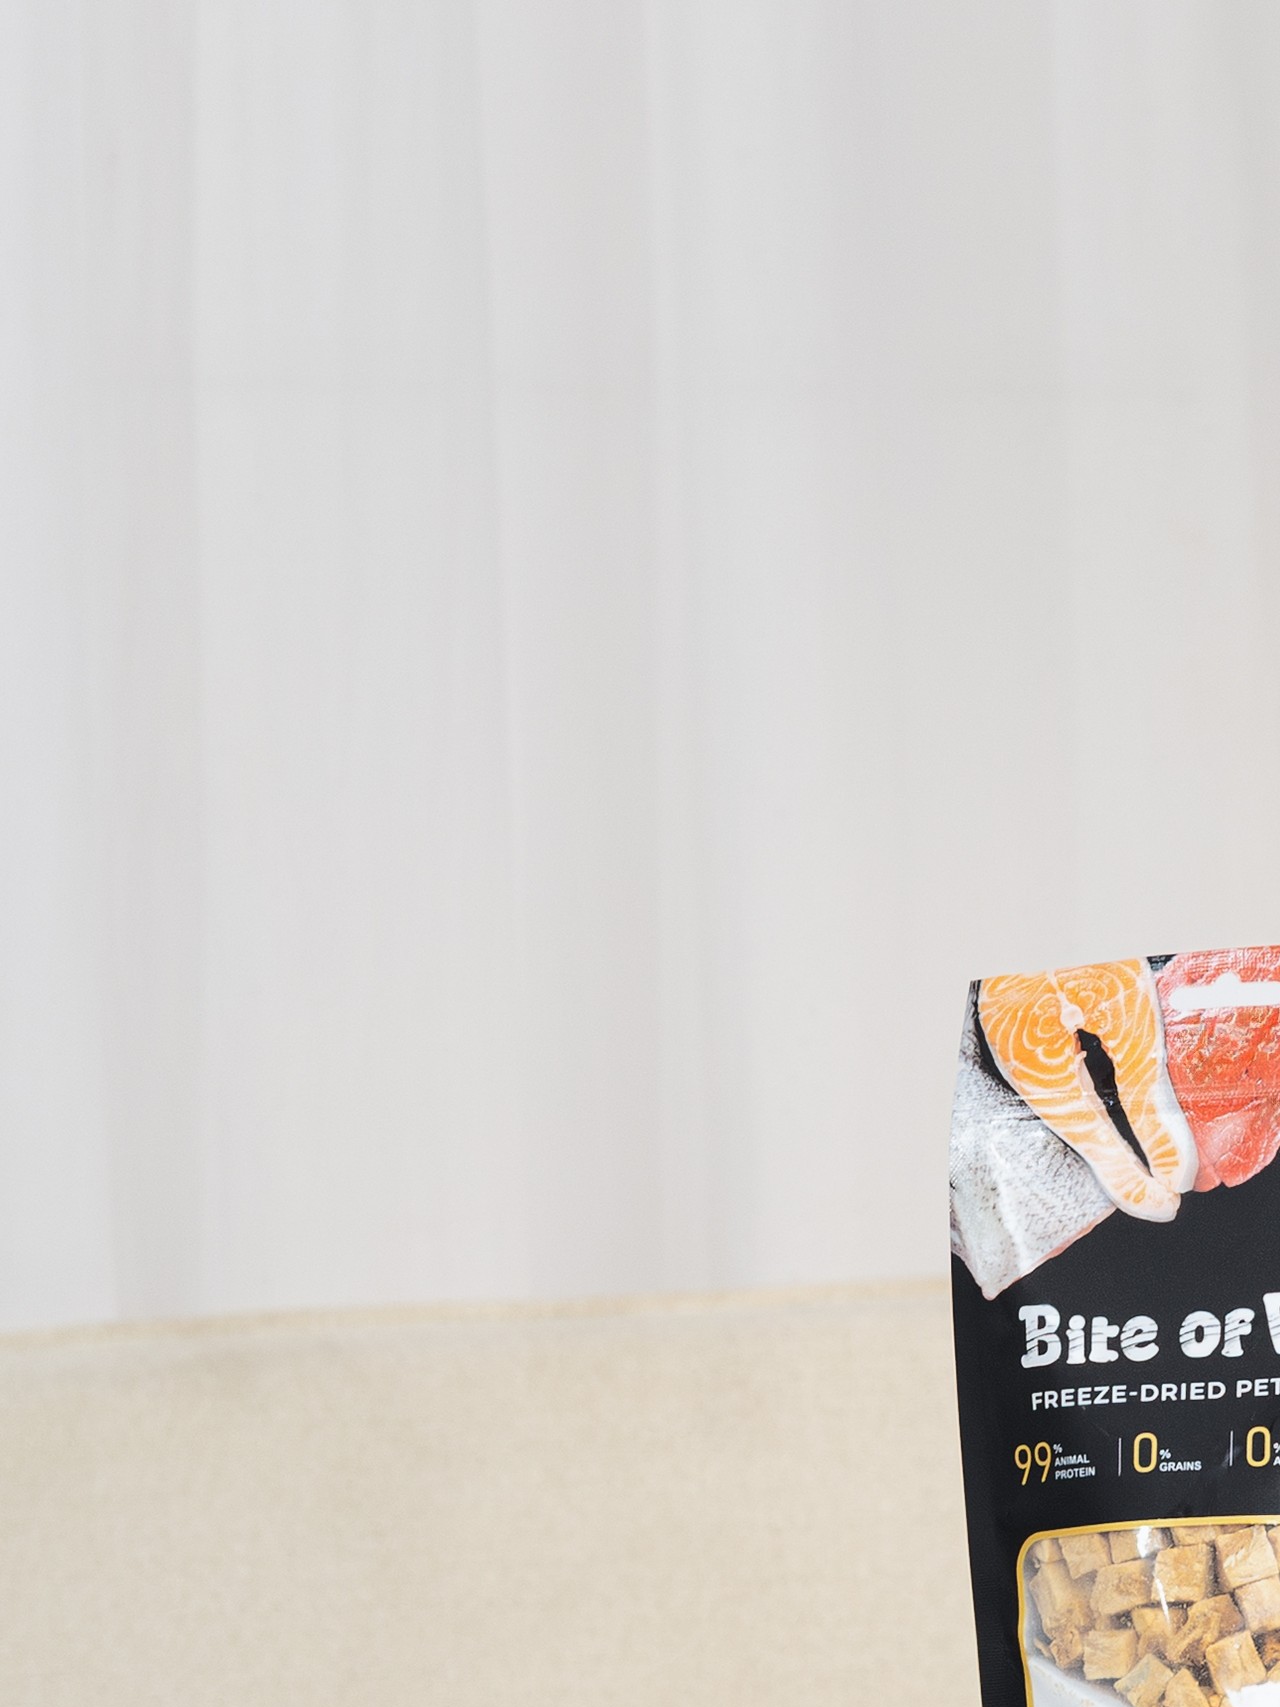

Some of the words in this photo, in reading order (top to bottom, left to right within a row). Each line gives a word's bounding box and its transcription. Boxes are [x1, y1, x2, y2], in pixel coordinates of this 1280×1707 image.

[1019, 1304, 1159, 1368] Bite
[1179, 1308, 1255, 1358] of
[1031, 1381, 1226, 1410] FREEZE-DRIED
[1054, 1454, 1090, 1467] ANIMAL
[1159, 1461, 1202, 1472] GRAINS
[1055, 1467, 1096, 1480] PROTEIN
